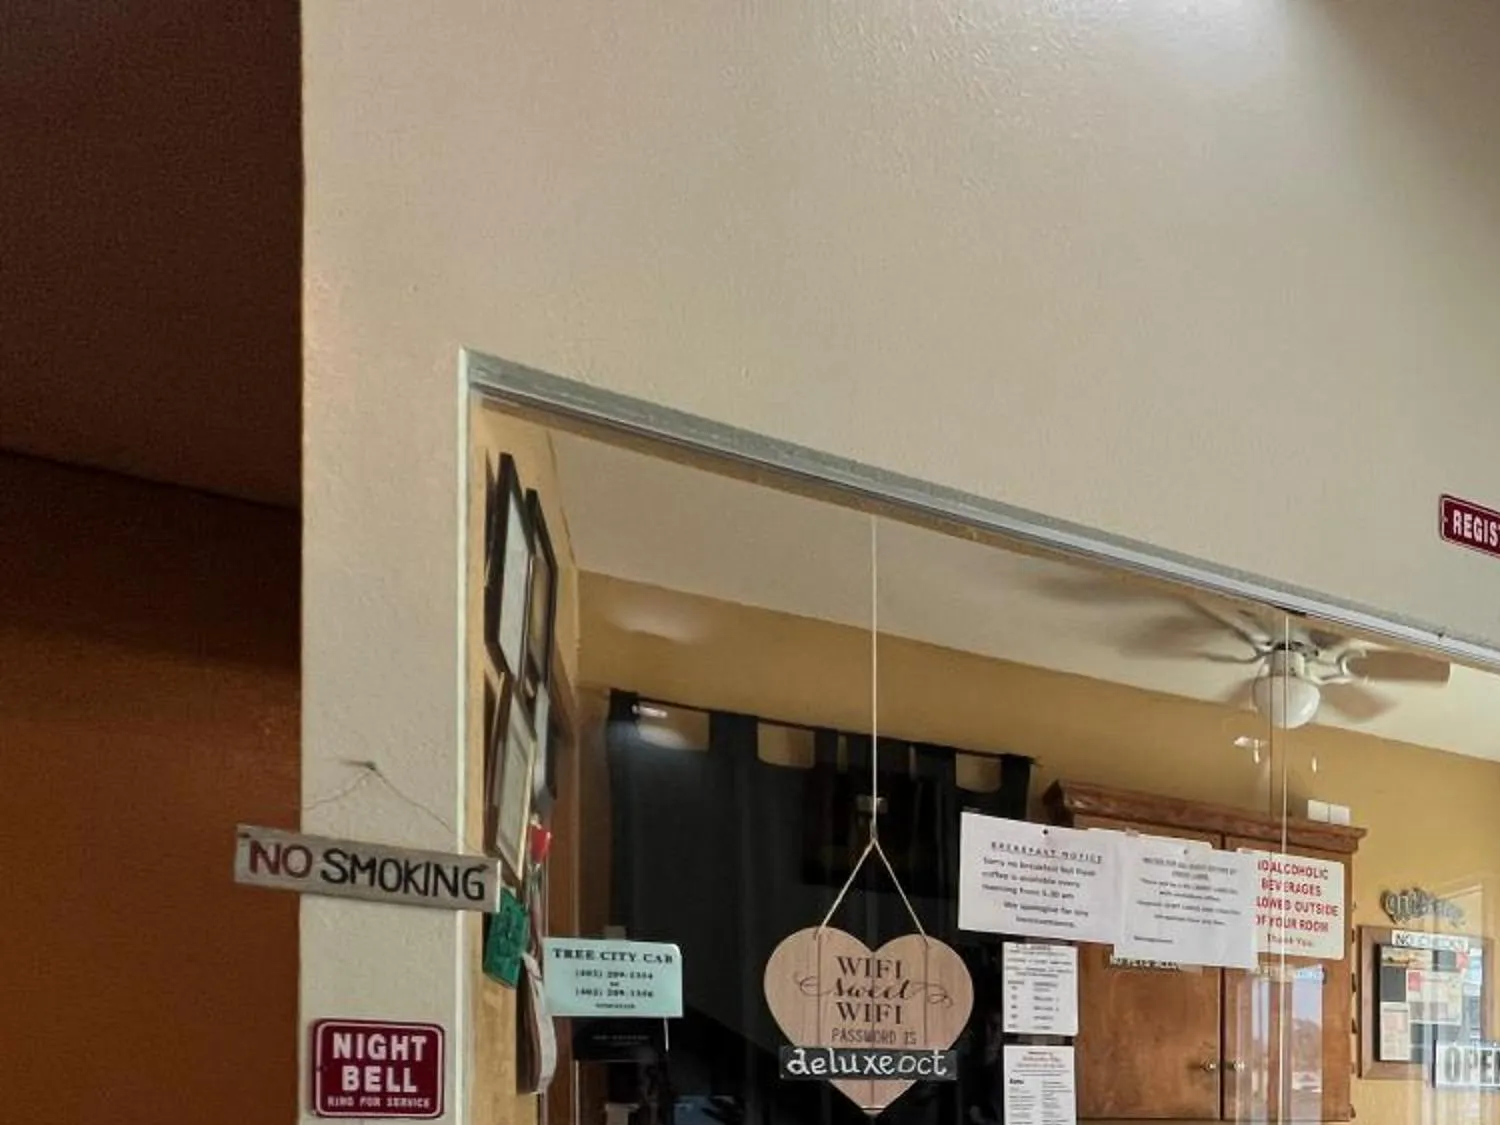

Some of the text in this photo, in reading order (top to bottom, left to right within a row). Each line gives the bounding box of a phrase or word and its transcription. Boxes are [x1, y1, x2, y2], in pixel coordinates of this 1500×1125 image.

[249, 840, 485, 900] NO SMOKING
[1270, 860, 1328, 880] ALCOHOLIC
[1261, 877, 1322, 897] BEVERAGES
[1256, 895, 1291, 911] LOWED
[1294, 901, 1339, 916] OUTSIDE
[1269, 915, 1297, 930] YOUR
[1298, 918, 1329, 933] ROOM
[552, 948, 673, 964] TREE CITY CAB
[837, 955, 904, 980] WIFI
[837, 1001, 903, 1025] WIFI
[333, 1032, 427, 1062] NIGHT
[831, 1028, 917, 1046] PASSWORD IS
[341, 1065, 417, 1093] BELL
[328, 1096, 431, 1108] RING FOR SERVICE
